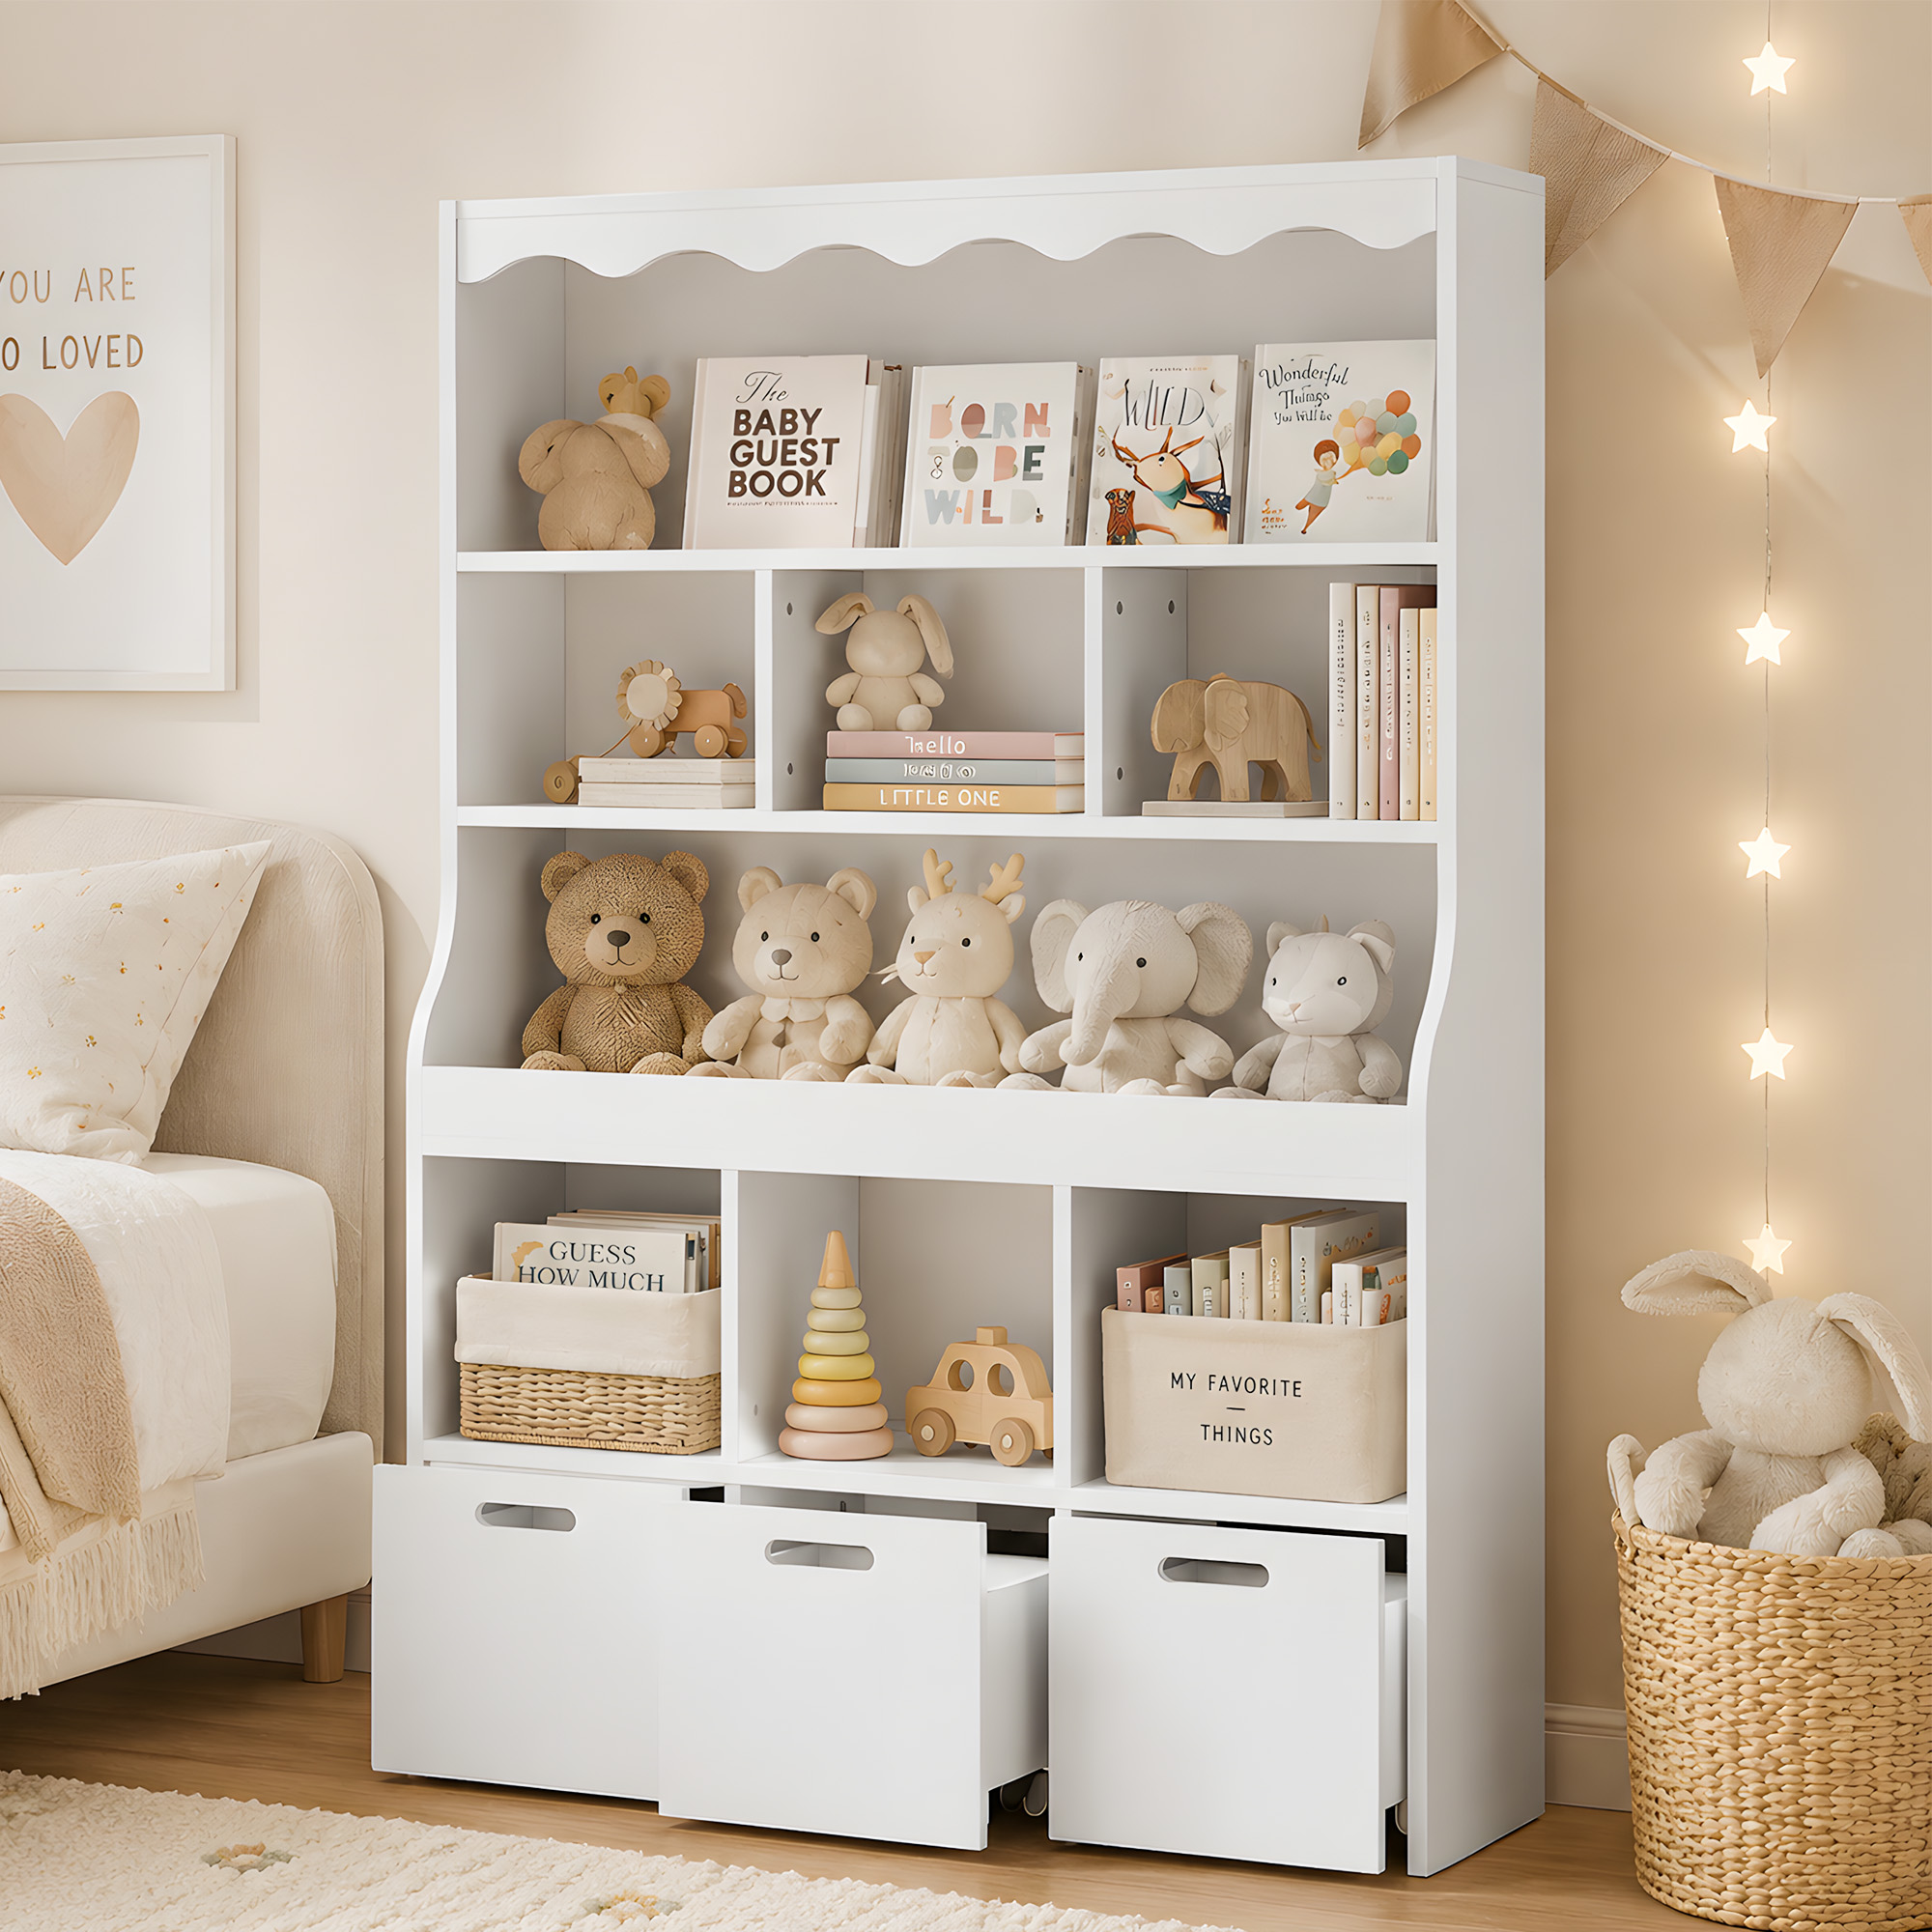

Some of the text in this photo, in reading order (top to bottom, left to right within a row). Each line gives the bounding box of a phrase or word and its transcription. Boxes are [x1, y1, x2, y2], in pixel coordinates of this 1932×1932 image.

[0, 267, 136, 304] OU ARE
[43, 333, 144, 370] LOVED
[735, 371, 789, 404] The
[733, 408, 823, 437] BABY
[929, 402, 1051, 439] BORN
[729, 438, 840, 468] GUEST
[927, 445, 1045, 482] TO BE
[728, 469, 827, 497] BOOK
[957, 788, 1001, 807] ONE
[549, 1240, 637, 1265] GUESS
[518, 1264, 665, 1293] HOW MUCH
[1171, 1372, 1302, 1398] MY FAVORITE
[1200, 1424, 1273, 1446] THINGS
